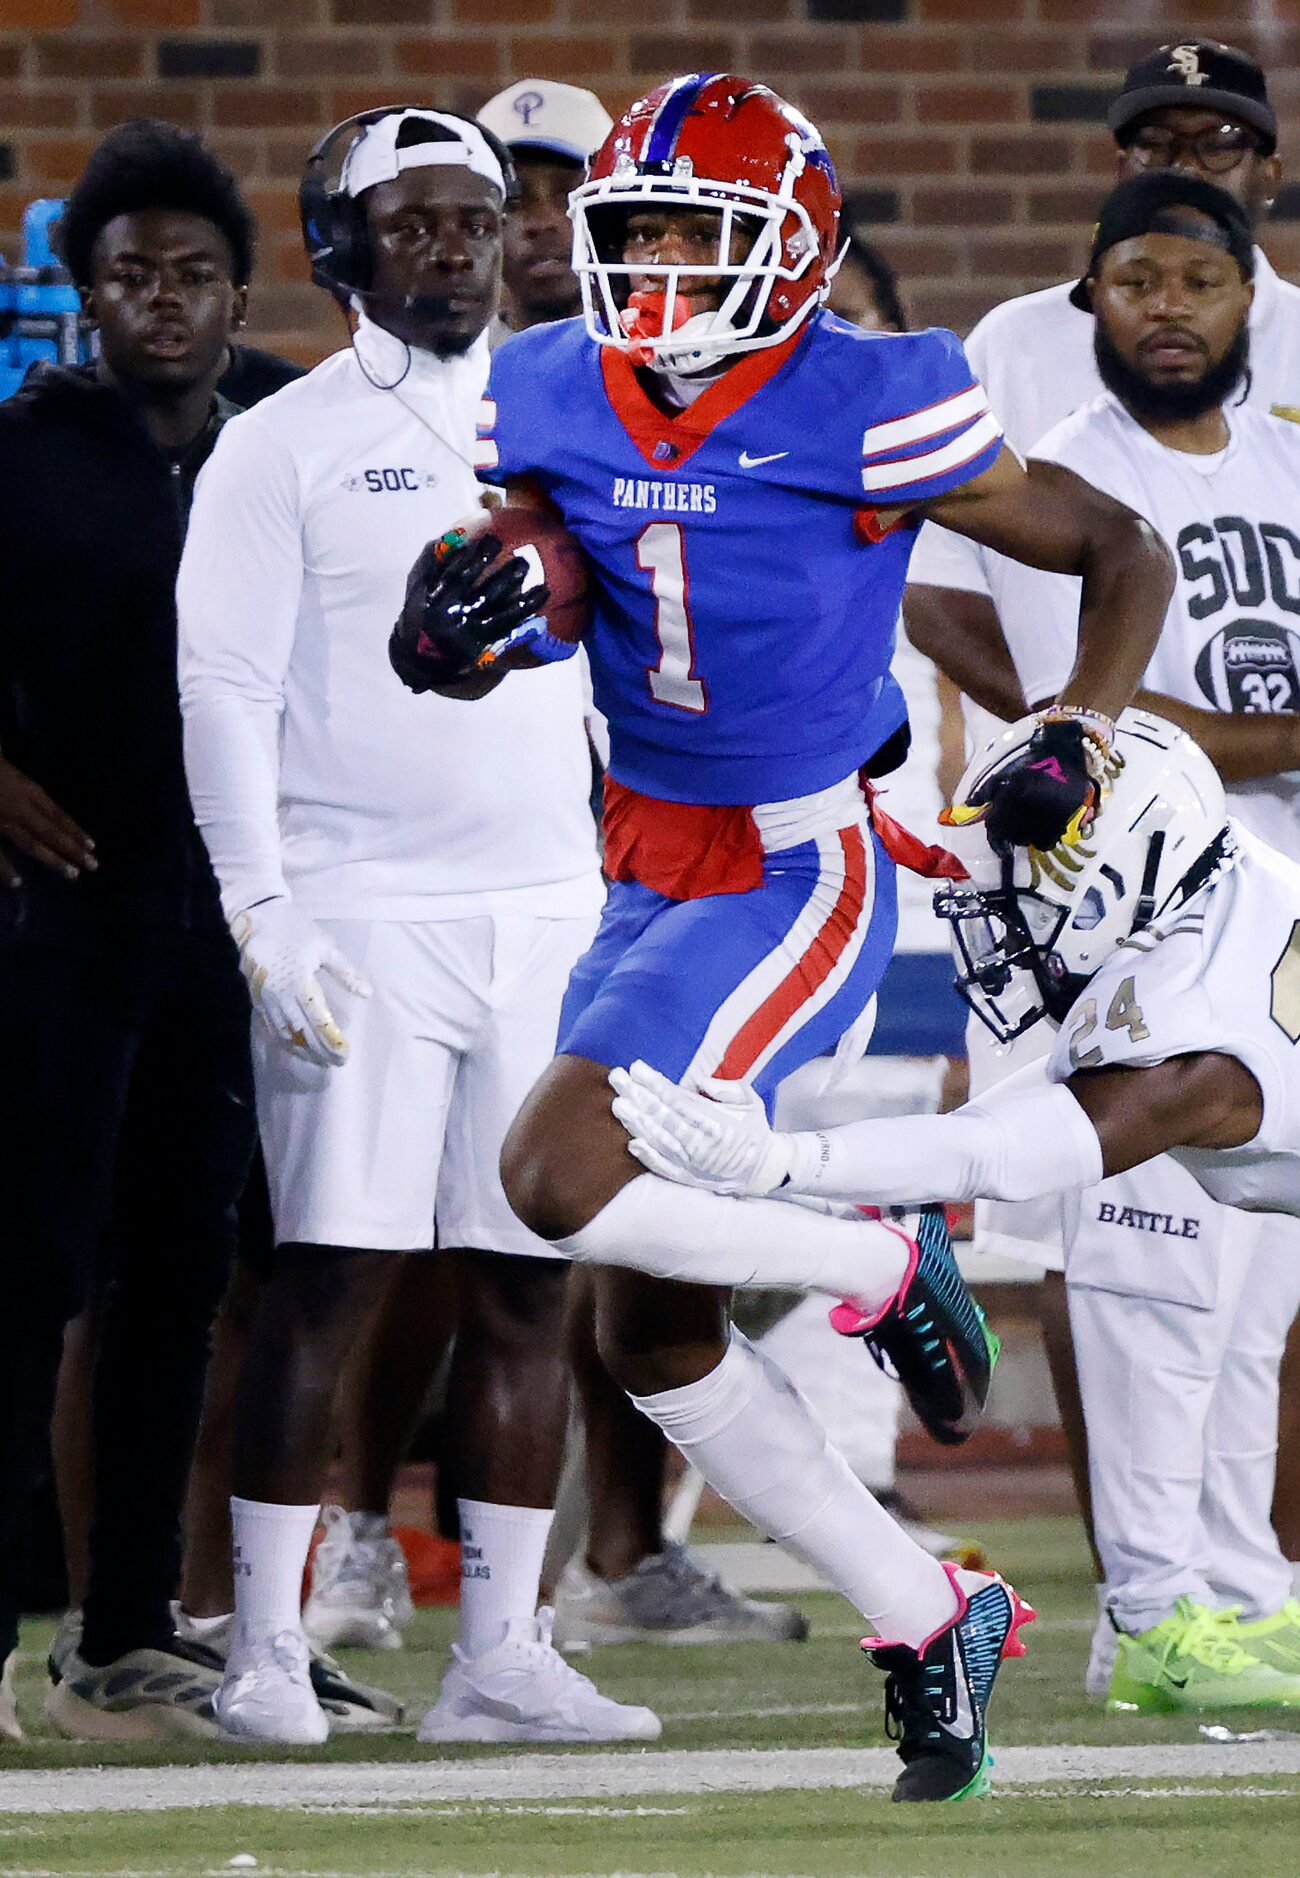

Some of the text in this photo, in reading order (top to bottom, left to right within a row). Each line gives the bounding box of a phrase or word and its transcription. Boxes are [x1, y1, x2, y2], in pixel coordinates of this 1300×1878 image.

[364, 468, 418, 492] SOC
[612, 477, 717, 513] PANTHERS
[634, 519, 708, 715] 1
[1241, 672, 1295, 715] 32
[1067, 975, 1151, 1069] 24
[1096, 1201, 1200, 1240] BATTLE
